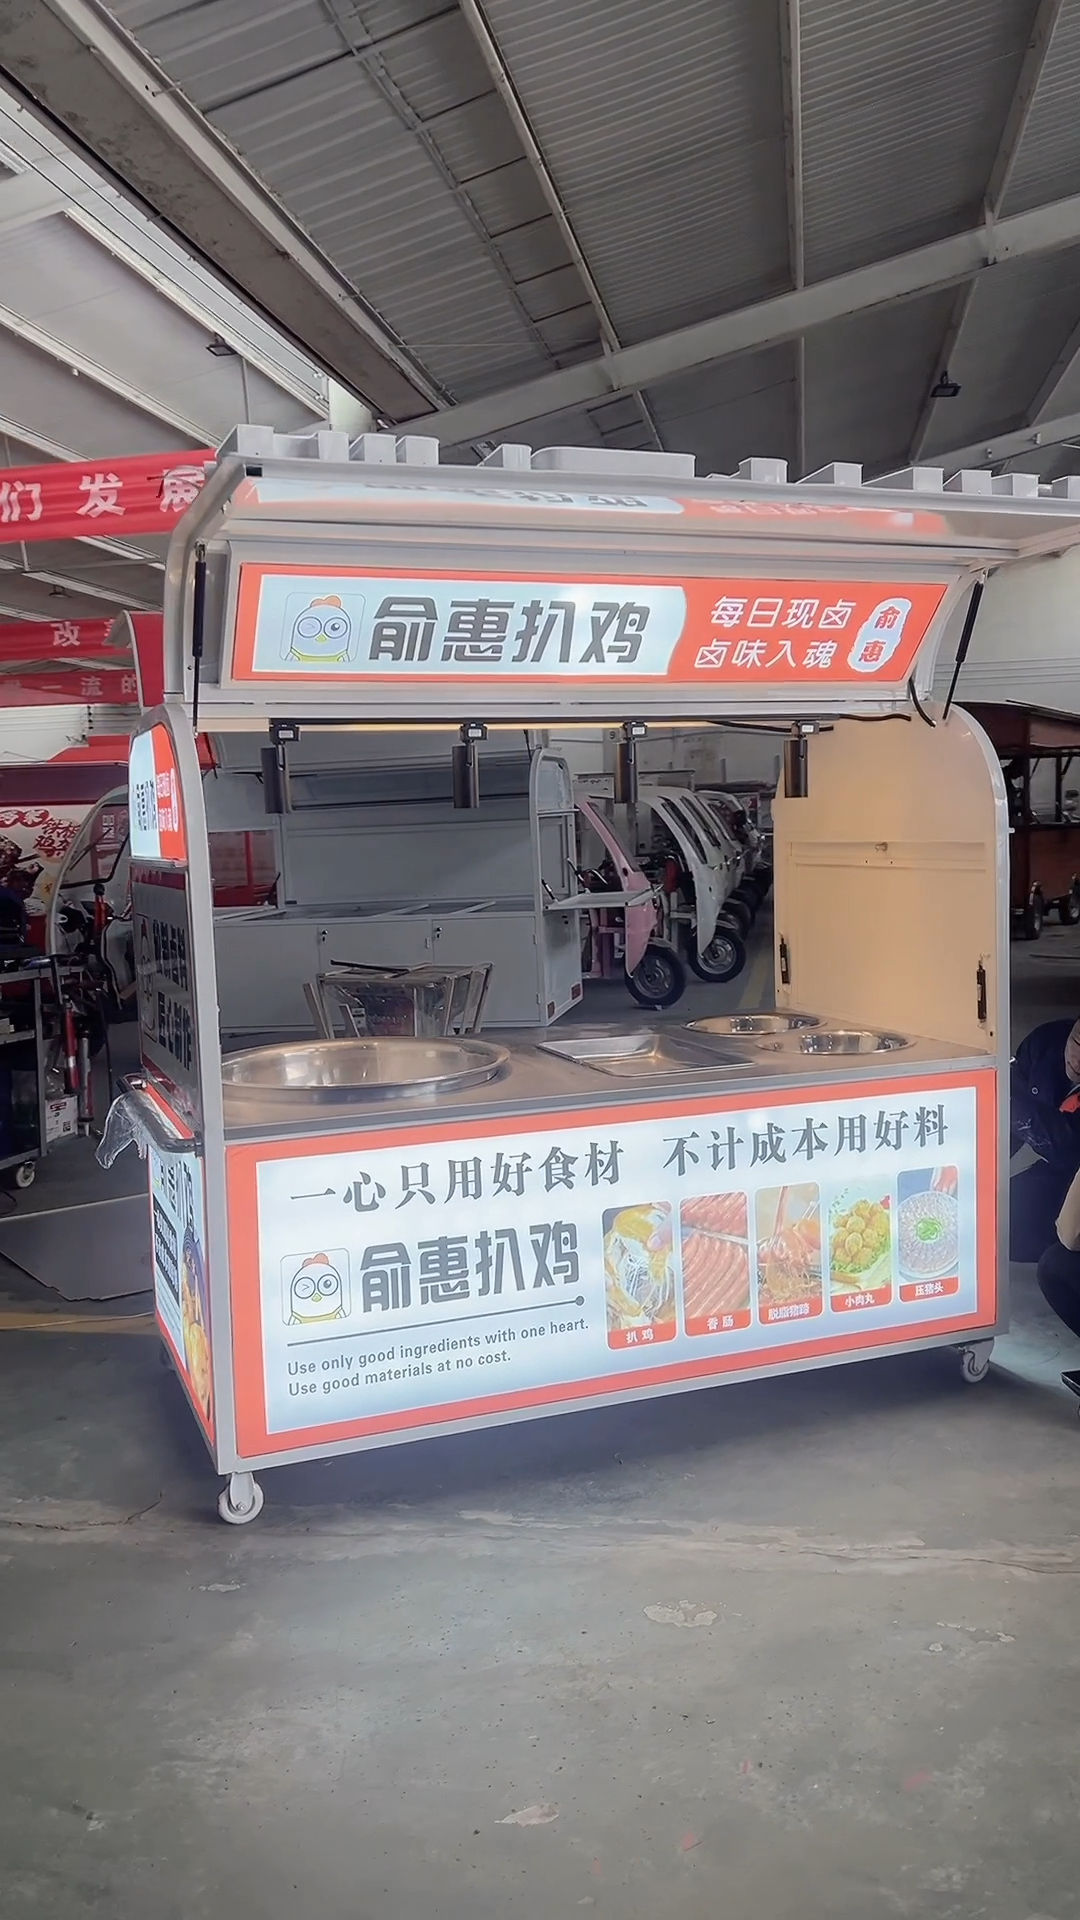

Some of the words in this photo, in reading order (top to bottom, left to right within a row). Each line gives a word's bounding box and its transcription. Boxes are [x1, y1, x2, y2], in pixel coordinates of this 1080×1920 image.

[369, 597, 650, 663] 俞惠扒鸡
[711, 595, 856, 628] 每日现卤
[858, 606, 901, 663] 俞惠
[694, 638, 838, 668] 卤味入魂
[663, 1104, 949, 1177] 不计成本用好料
[290, 1140, 624, 1212] 一心只用好食材
[360, 1220, 580, 1313] 俞惠扒鸡
[706, 1314, 734, 1331] 香肠
[844, 1292, 875, 1308] 小肉丸
[288, 1360, 317, 1376] Use
[321, 1353, 354, 1372] only
[358, 1346, 396, 1368] good
[399, 1333, 482, 1359] ingredients
[485, 1329, 516, 1345] with
[520, 1326, 546, 1340] one
[550, 1317, 589, 1335] heart.
[625, 1328, 655, 1344] 扒鸡
[288, 1381, 318, 1397] Use
[322, 1373, 360, 1394] good
[365, 1361, 433, 1385] materials
[437, 1358, 452, 1373] at
[455, 1357, 474, 1370] no
[477, 1350, 512, 1366] cost.
